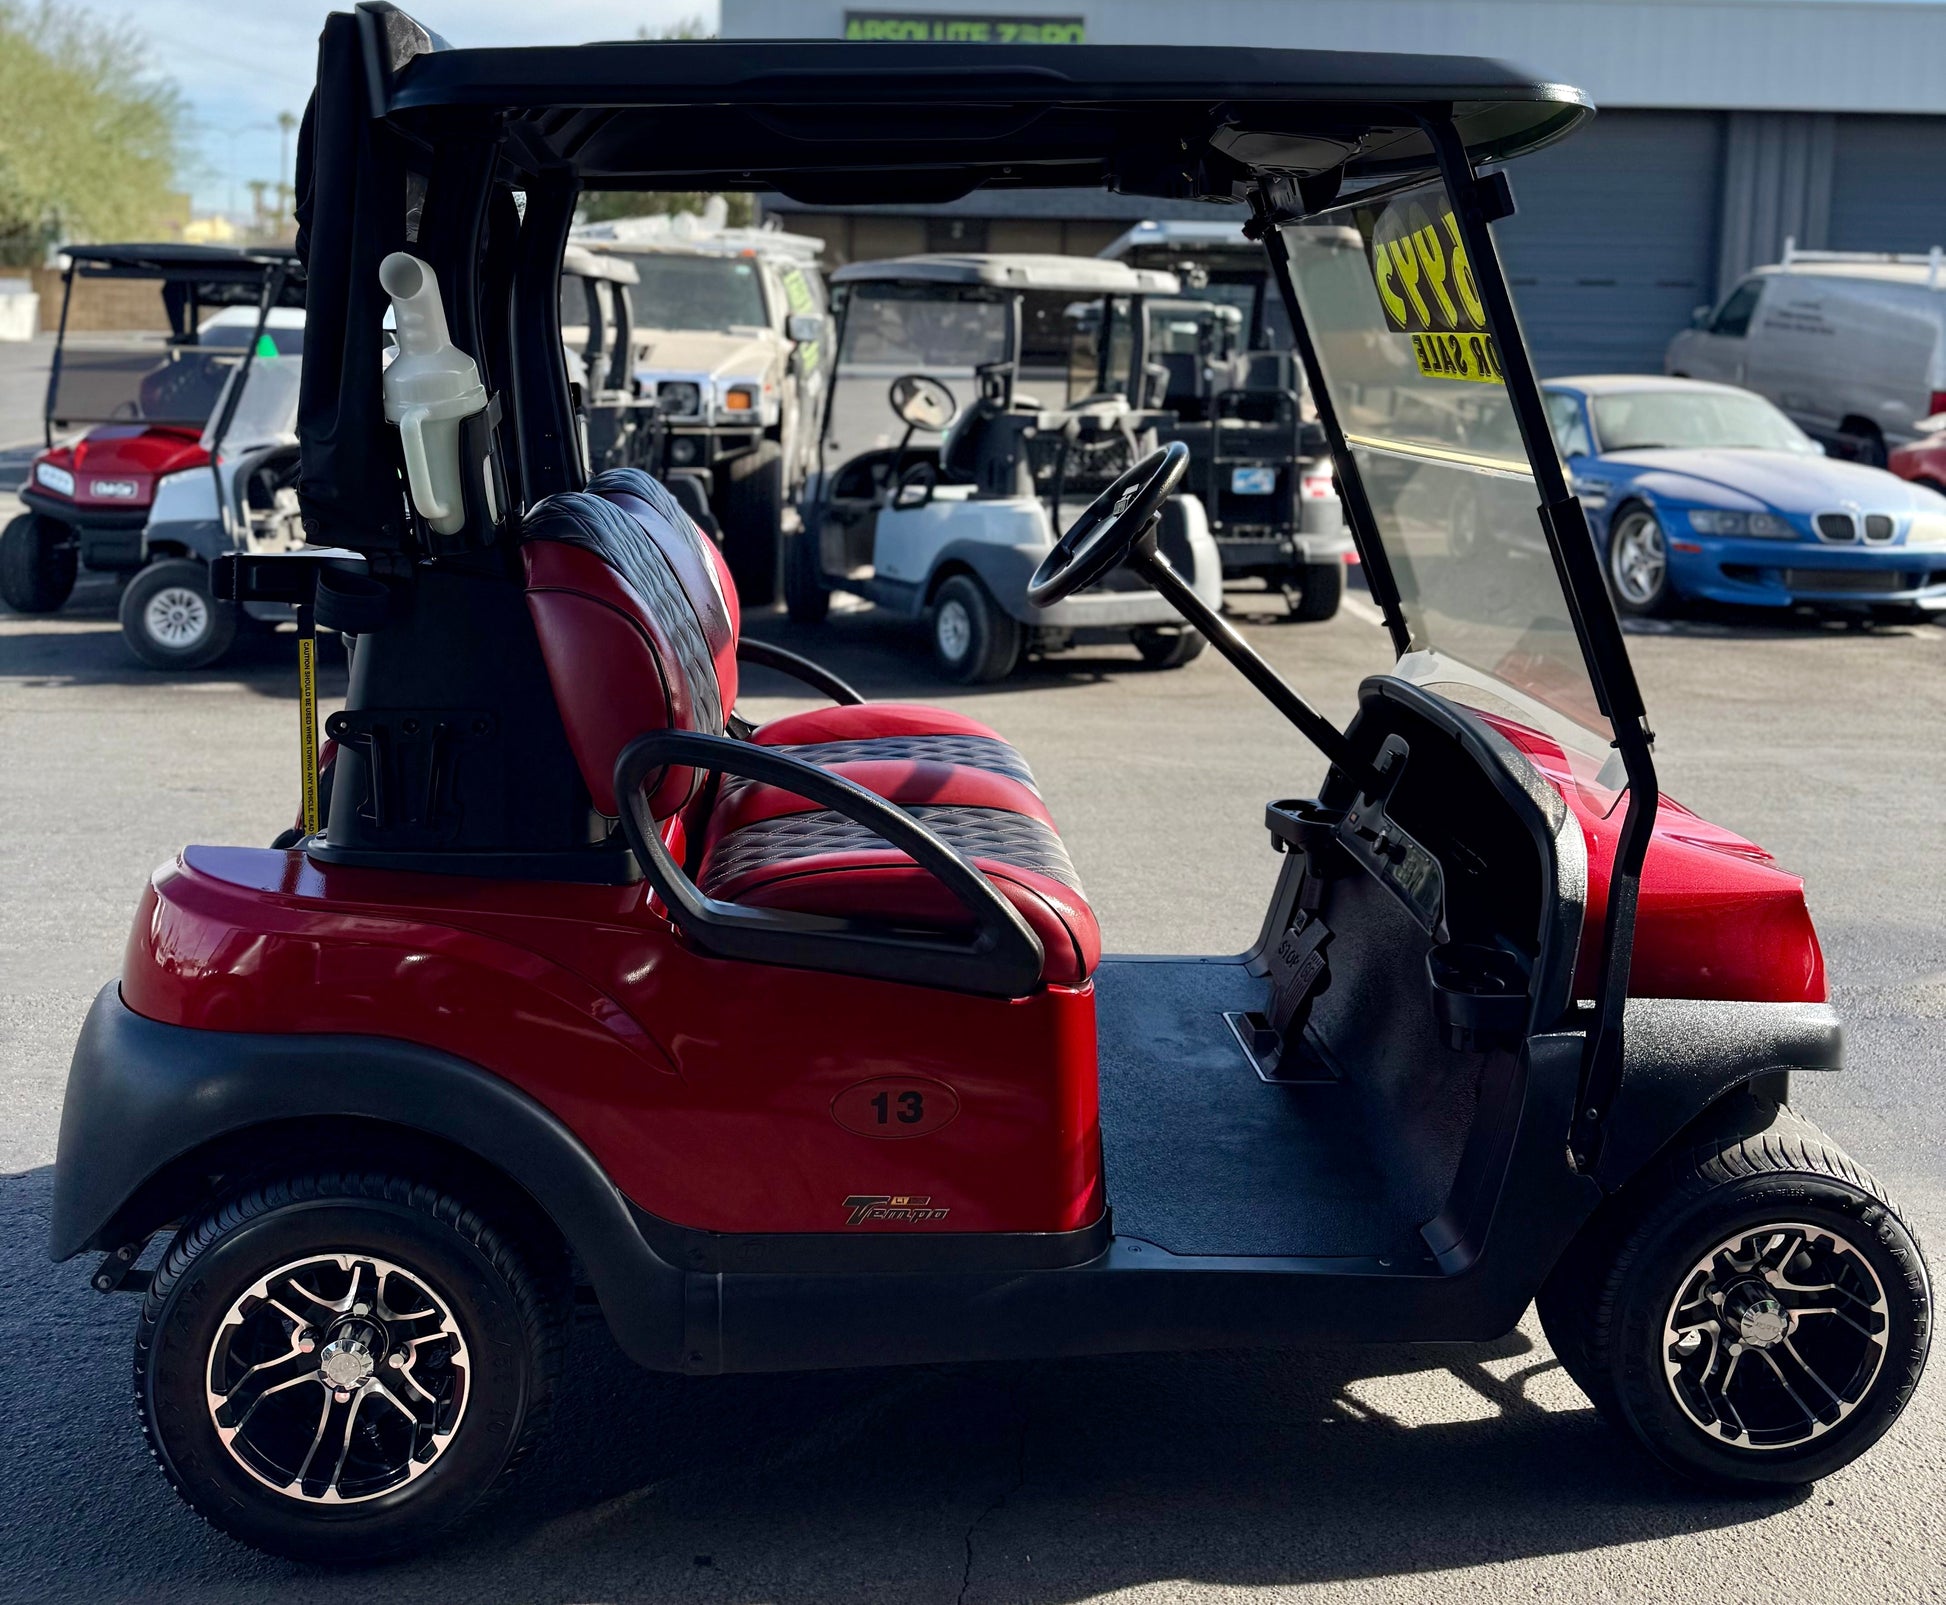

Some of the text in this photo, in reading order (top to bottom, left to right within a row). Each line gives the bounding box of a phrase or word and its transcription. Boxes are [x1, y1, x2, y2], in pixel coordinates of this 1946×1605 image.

[303, 641, 311, 670] CAUTION
[304, 671, 312, 697] SHOULD
[305, 698, 312, 707] BE
[305, 707, 313, 725] USED
[870, 1091, 924, 1124] 13
[842, 1195, 950, 1225] Tempo
